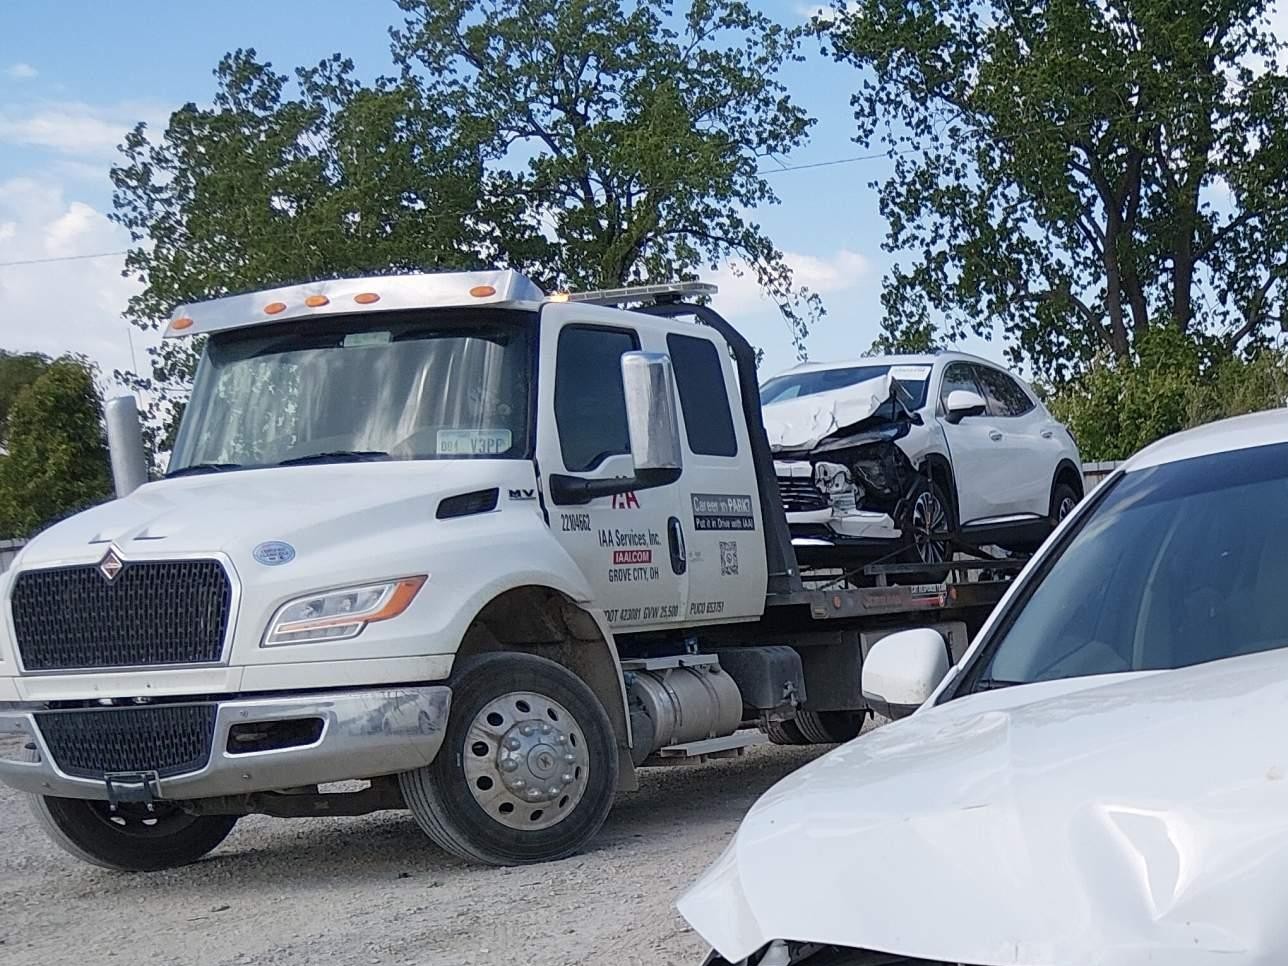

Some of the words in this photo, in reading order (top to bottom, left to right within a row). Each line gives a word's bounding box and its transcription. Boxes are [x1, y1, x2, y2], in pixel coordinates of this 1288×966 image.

[508, 488, 534, 498] MV
[598, 530, 614, 547] IAA
[615, 529, 649, 548] Services,
[648, 529, 661, 546] Inc.
[608, 568, 631, 583] GROVE
[632, 568, 648, 582] CITY,
[650, 567, 659, 580] OH
